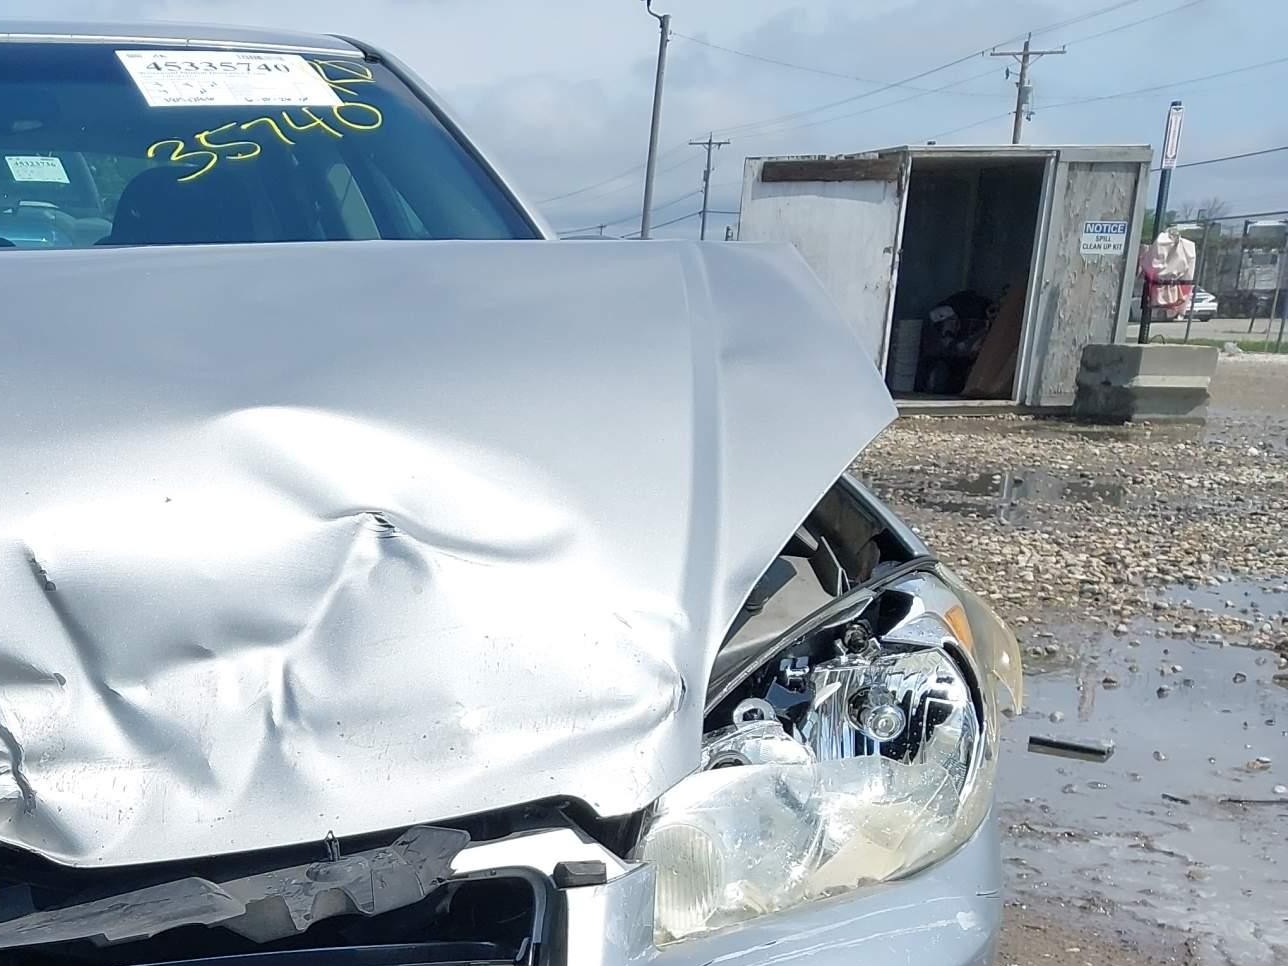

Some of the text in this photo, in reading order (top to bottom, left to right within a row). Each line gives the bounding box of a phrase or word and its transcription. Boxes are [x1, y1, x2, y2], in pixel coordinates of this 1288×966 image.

[146, 61, 291, 73] 45335740
[147, 102, 382, 181] 35740
[1085, 223, 1125, 233] NOTICE
